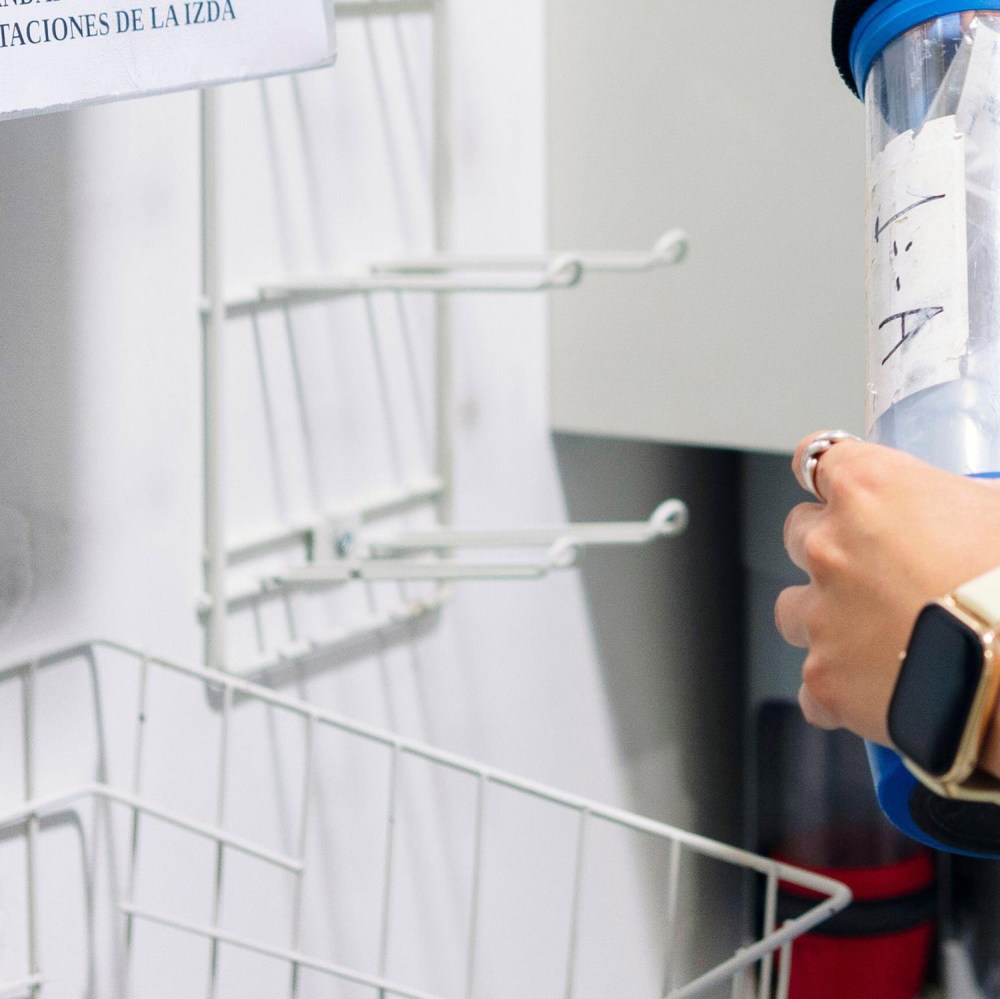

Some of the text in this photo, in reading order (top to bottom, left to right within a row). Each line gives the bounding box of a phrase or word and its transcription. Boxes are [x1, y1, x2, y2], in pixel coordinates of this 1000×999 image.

[0, 12, 110, 48] TACIONES
[115, 8, 145, 33] DE
[150, 3, 180, 29] LA
